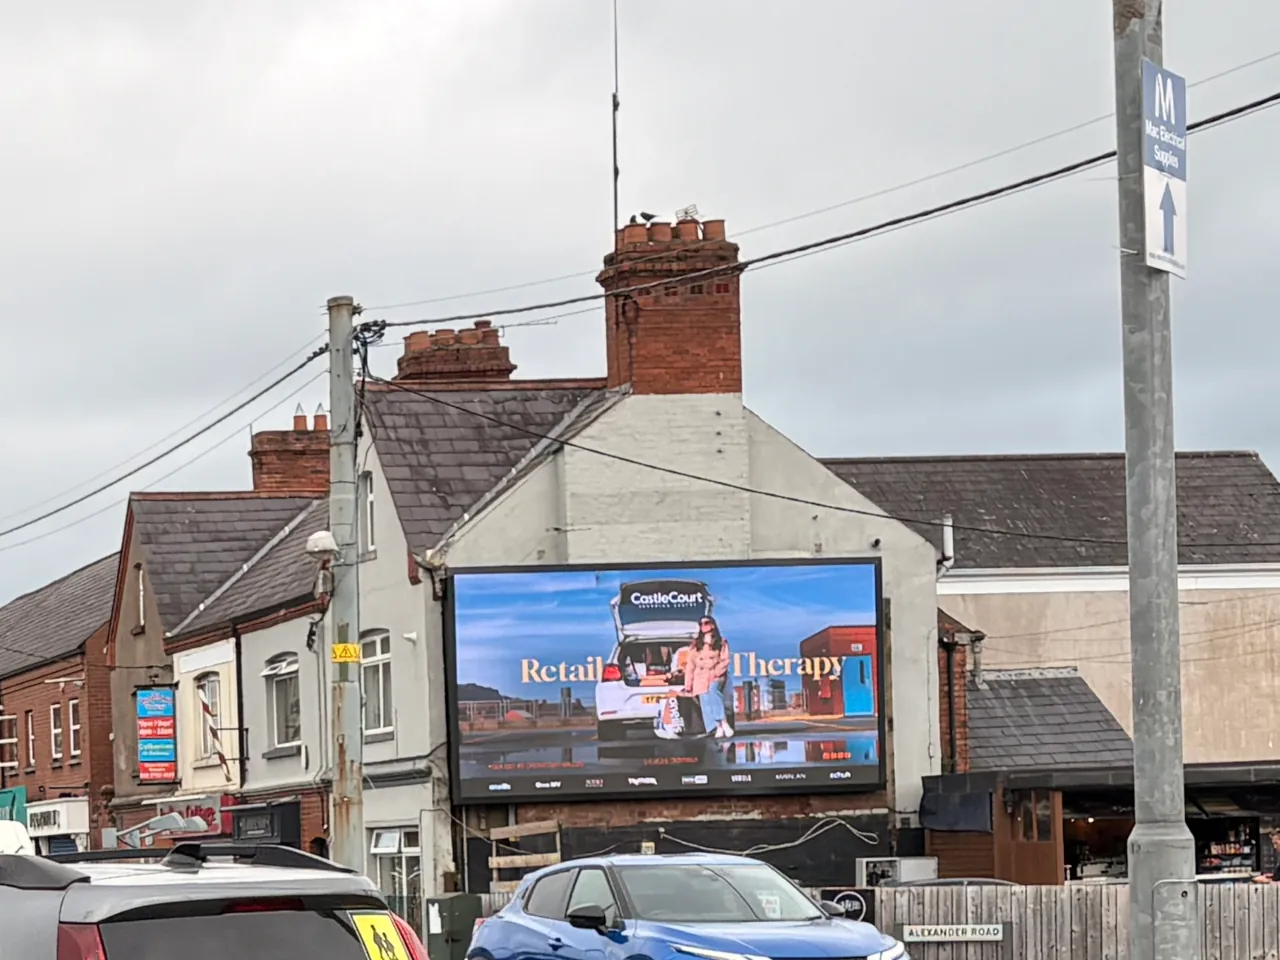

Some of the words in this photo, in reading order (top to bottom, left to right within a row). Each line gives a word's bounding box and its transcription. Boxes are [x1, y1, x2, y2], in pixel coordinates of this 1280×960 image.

[1155, 73, 1175, 125] M
[1145, 119, 1159, 139] Mac
[1160, 125, 1185, 150] Electrical
[1153, 144, 1179, 169] Supplies
[630, 590, 703, 604] CastleCourt
[521, 656, 603, 683] Retail
[732, 651, 847, 681] Therapy
[908, 928, 968, 938] ALEXANDER
[971, 928, 1000, 937] ROAD
